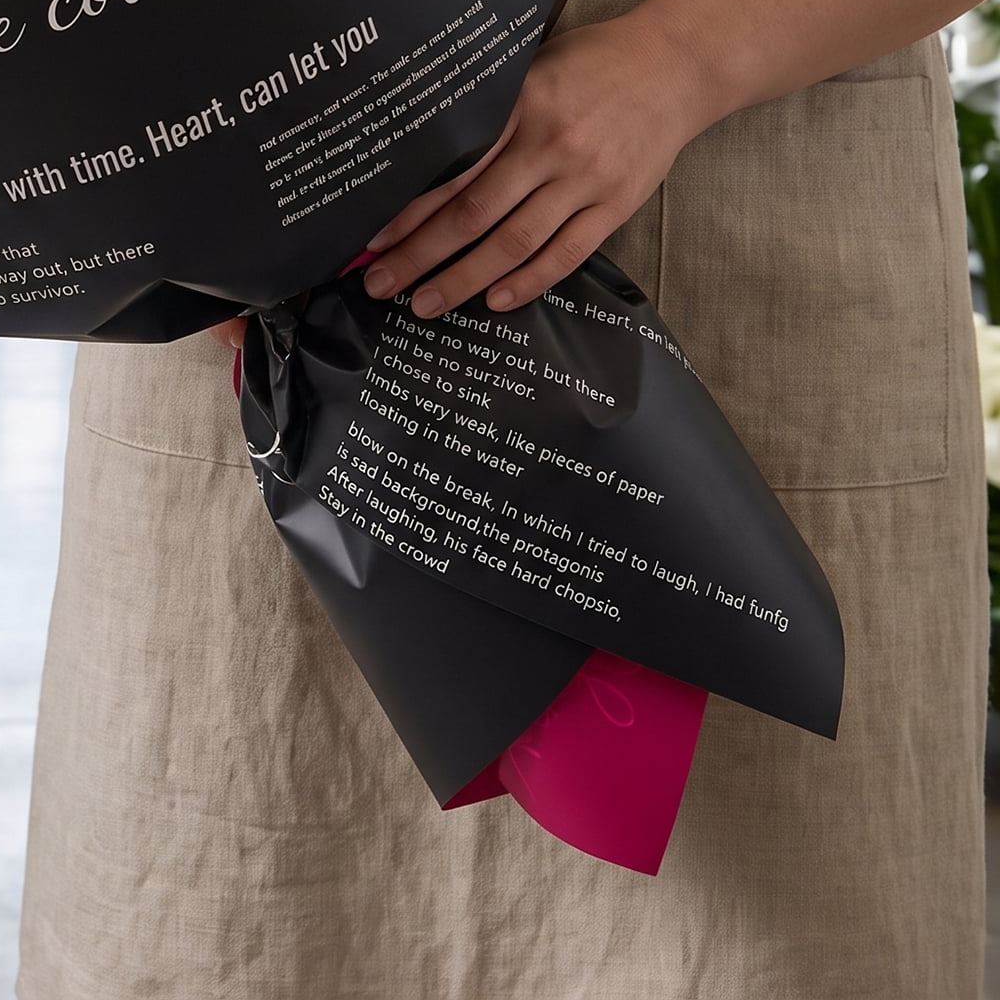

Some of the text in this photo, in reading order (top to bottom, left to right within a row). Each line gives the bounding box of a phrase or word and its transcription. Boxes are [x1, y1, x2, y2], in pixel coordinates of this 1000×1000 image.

[2, 163, 66, 202] with
[70, 145, 144, 184] time.
[145, 98, 235, 157] Heart,
[240, 71, 288, 113] can
[289, 42, 330, 85] let
[331, 17, 378, 67] you
[2, 243, 40, 260] that
[11, 284, 85, 303] survivor.
[33, 262, 67, 278] out,
[70, 254, 103, 271] but
[105, 243, 155, 264] there
[385, 311, 615, 406] I have no way out, but there
[496, 324, 530, 346] that
[544, 290, 578, 314] time.
[585, 303, 633, 331] Heart,
[639, 325, 662, 344] can
[373, 345, 491, 409] I chose to sink
[382, 333, 535, 400] will be no surzivor.
[360, 389, 524, 477] floating in the water
[366, 367, 664, 505] limbs very weak, like pieces of paper
[319, 485, 450, 573] Stay in the crowd
[327, 466, 621, 622] After laughing, his face hard chopsio,
[337, 441, 349, 459] is
[351, 457, 379, 479] sad
[512, 538, 604, 583] protagonis
[348, 420, 789, 632] blow on the break, In which I tried to laugh, I had funfg
